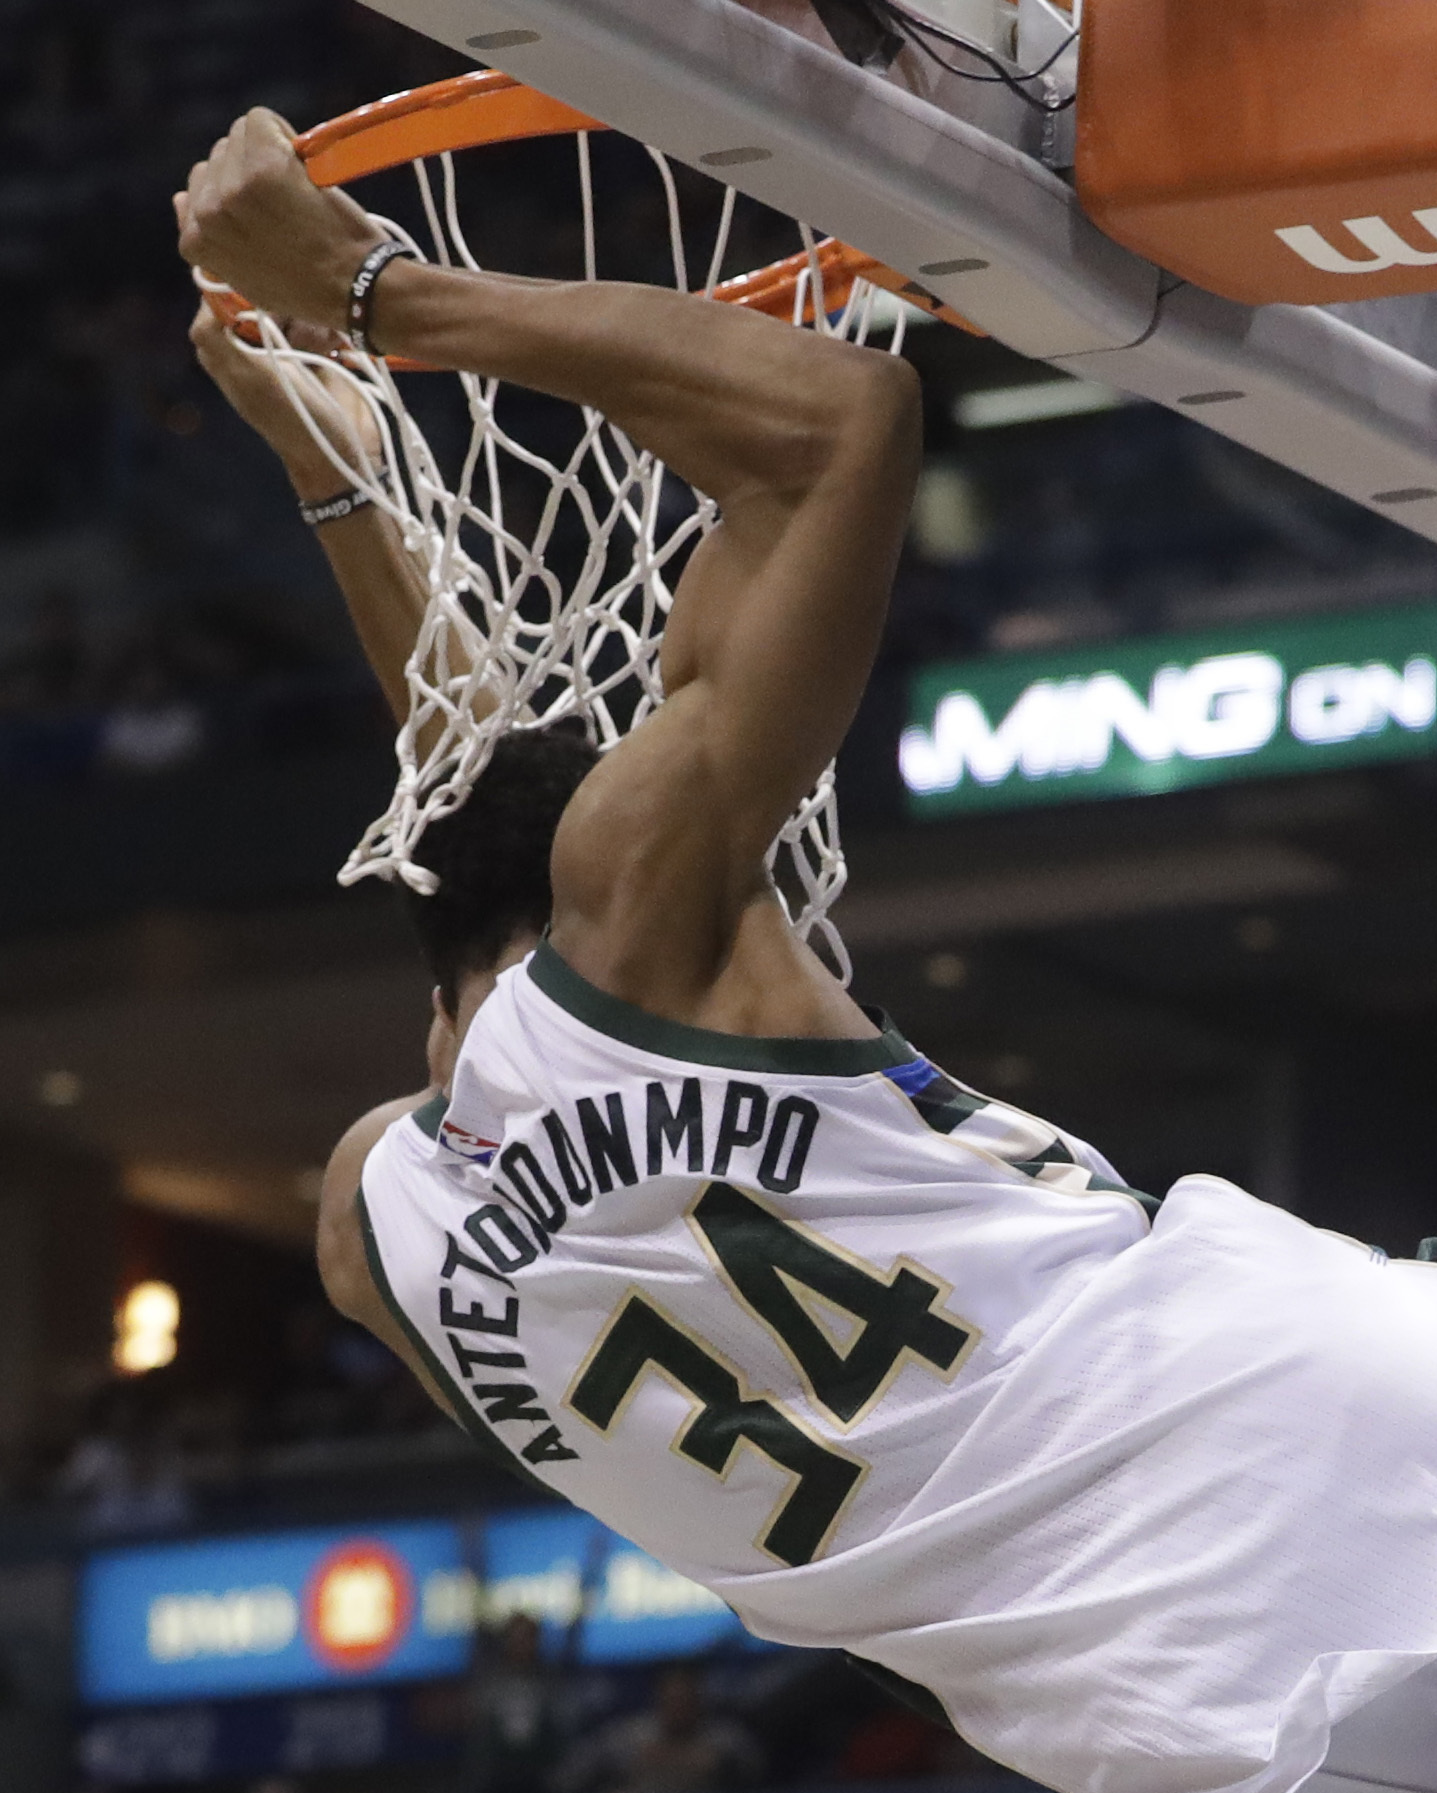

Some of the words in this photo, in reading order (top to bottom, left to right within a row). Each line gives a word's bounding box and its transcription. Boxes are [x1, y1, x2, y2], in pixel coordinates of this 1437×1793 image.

[1290, 656, 1437, 745] ON
[438, 1076, 820, 1467] ANTETOOUNMPO
[560, 1176, 984, 1570] 34
